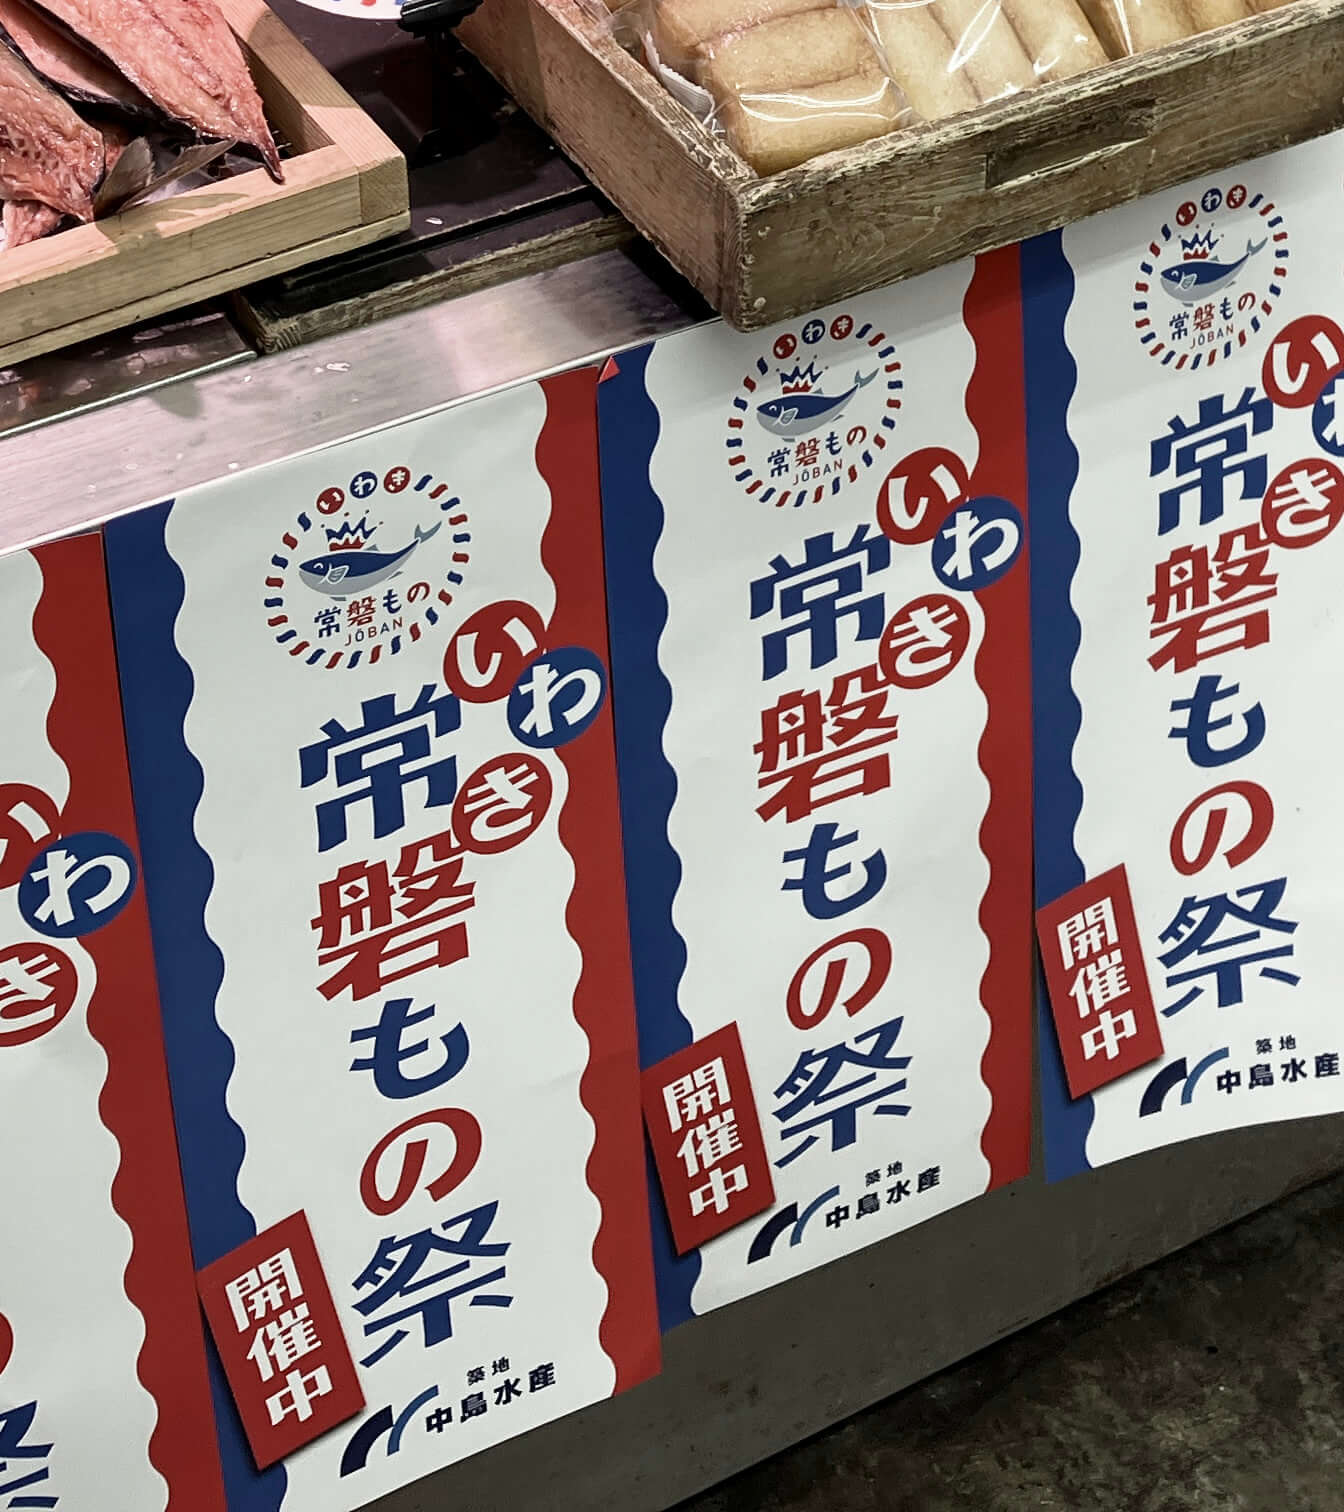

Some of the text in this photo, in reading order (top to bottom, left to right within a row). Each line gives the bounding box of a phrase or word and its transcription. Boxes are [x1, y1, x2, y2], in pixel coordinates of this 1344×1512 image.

[1170, 290, 1255, 339] 常磐もの
[767, 425, 867, 478] 常磐もの
[314, 580, 431, 640] 常磐もの
[1146, 385, 1300, 1018] 常磐もの祭
[749, 523, 913, 1168] 常磐もの祭
[298, 684, 512, 1370] 常磐もの祭
[1057, 895, 1137, 1060] 開催中
[1216, 1051, 1341, 1095] 中島水産
[664, 1053, 748, 1216] 開催中
[825, 1164, 941, 1230] 中島水産
[224, 1245, 334, 1425] 開催中
[425, 1362, 557, 1434] 中島水産
